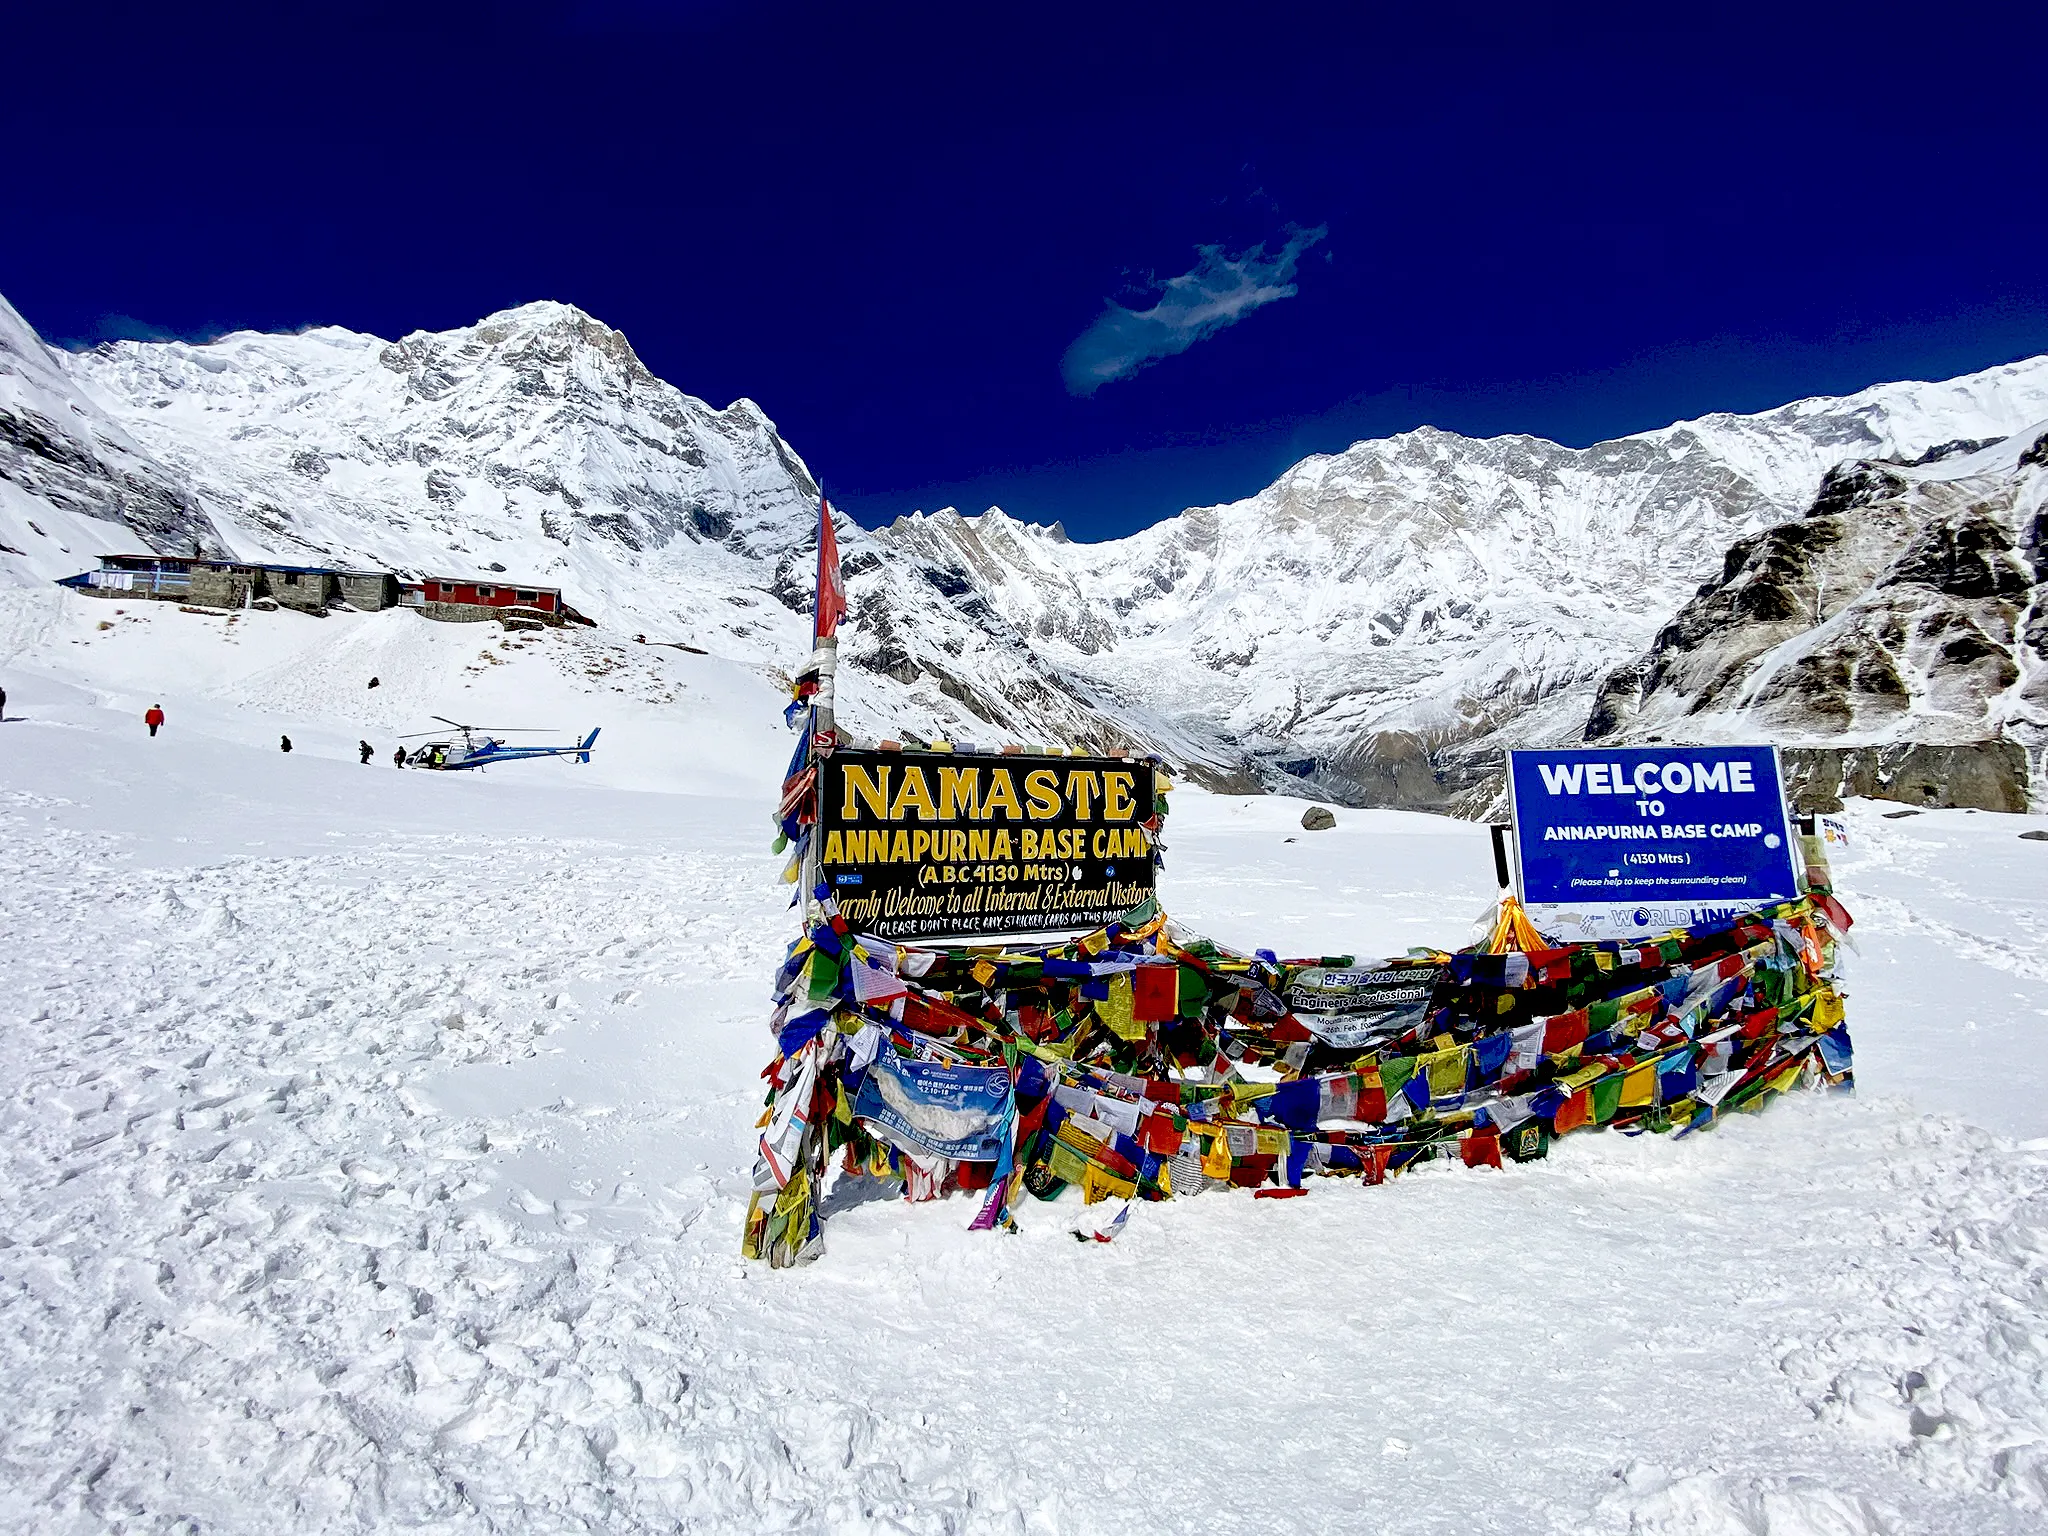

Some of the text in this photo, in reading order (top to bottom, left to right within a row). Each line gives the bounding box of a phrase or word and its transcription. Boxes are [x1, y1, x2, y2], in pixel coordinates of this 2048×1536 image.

[1538, 761, 1755, 795] WELCOME
[841, 764, 1137, 821] NAMASTE
[1636, 800, 1665, 816] TO
[1544, 823, 1762, 840] ANNAPURNA BASE CAMP
[823, 829, 1013, 864] ANNAPURNA
[1021, 828, 1086, 860] BASE
[1023, 862, 1069, 882] Mtrs)
[1571, 878, 1601, 887] (Please
[1603, 877, 1622, 886] help
[1634, 877, 1654, 886] keep
[1655, 876, 1669, 885] the
[1670, 875, 1719, 885] surrounding
[1721, 875, 1747, 884] clean)
[884, 886, 944, 917] Welcome
[948, 887, 960, 913] to
[962, 885, 983, 913] all
[985, 884, 1041, 912] Internal
[874, 920, 917, 936] (PLEASE
[920, 917, 949, 932] DON'T
[952, 917, 981, 932] PLACE
[1083, 911, 1101, 923] THIS
[1293, 996, 1349, 1010] Engineers
[1362, 987, 1425, 1003] ofessional
